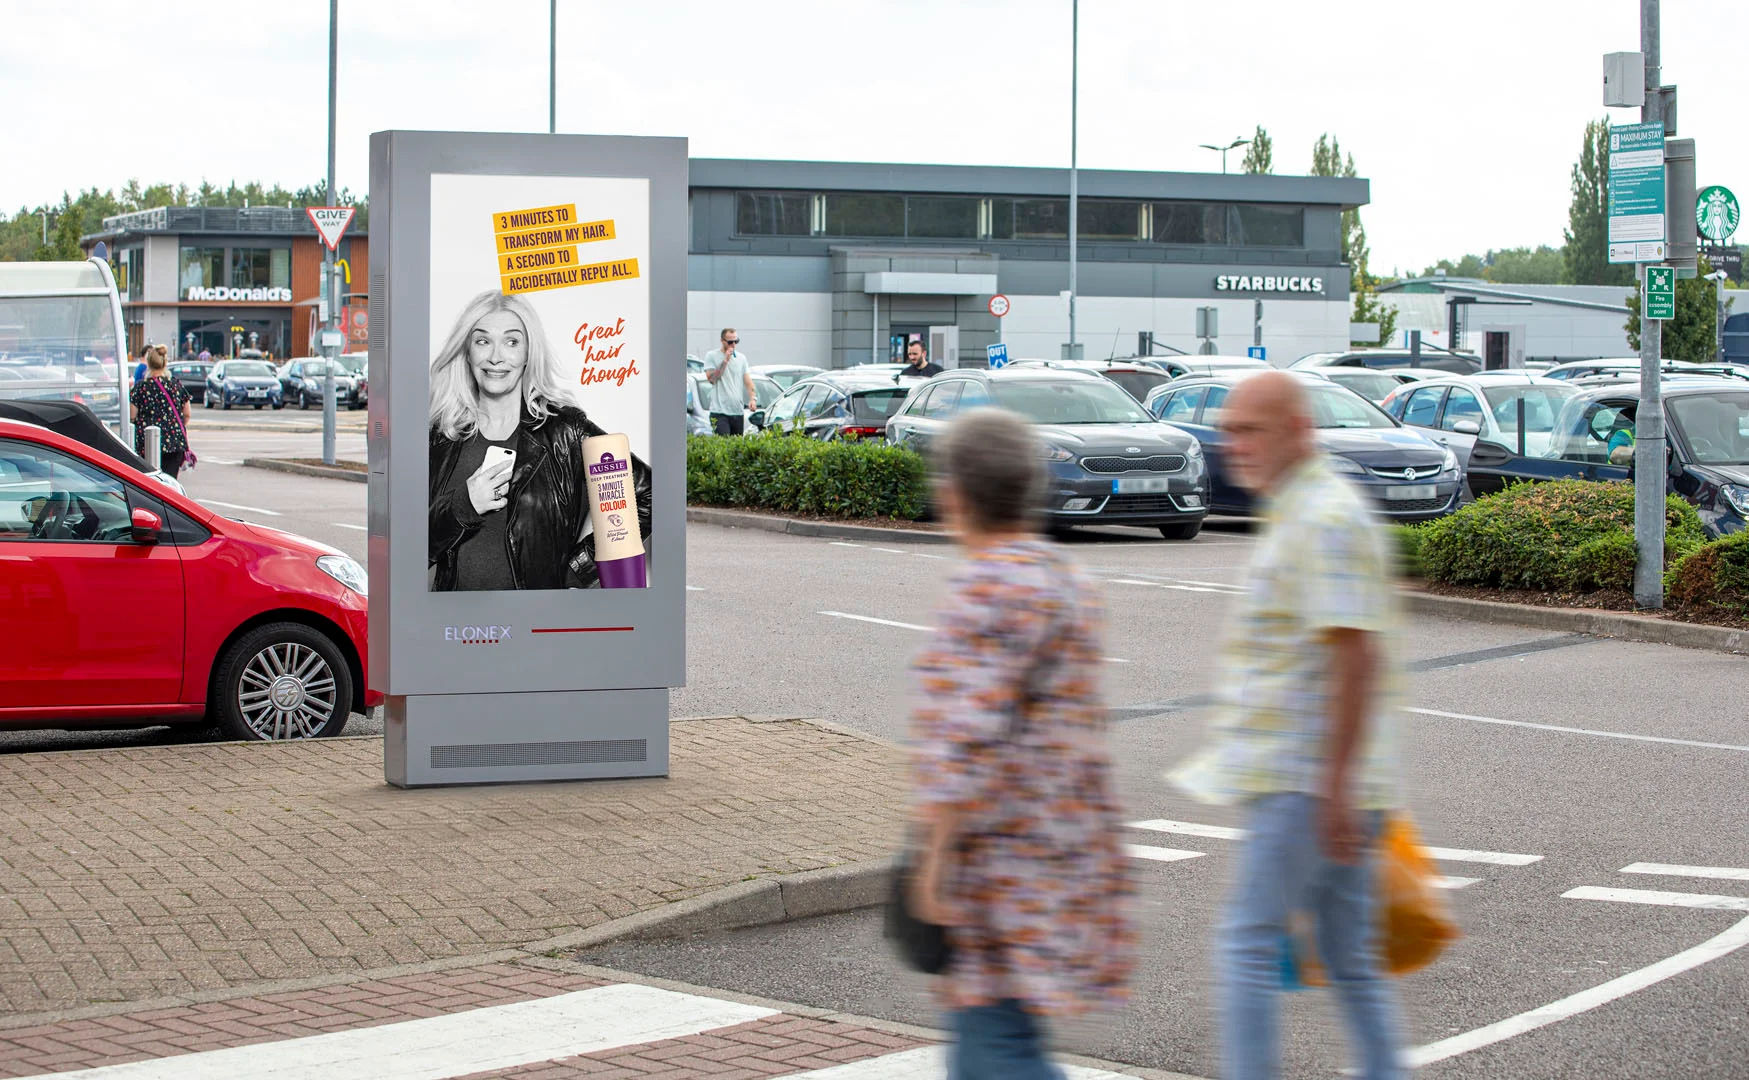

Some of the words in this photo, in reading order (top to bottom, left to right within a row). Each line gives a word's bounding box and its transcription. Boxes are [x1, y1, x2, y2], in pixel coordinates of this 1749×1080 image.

[1620, 132, 1648, 141] MAXIMUM
[1648, 130, 1662, 140] STAY
[316, 210, 347, 219] GIVE
[501, 216, 508, 229] 3
[510, 210, 554, 228] MINUTES
[556, 208, 569, 222] TO
[503, 230, 563, 250] TRANSFORM
[565, 227, 580, 241] MY
[583, 224, 609, 239] HAIR.
[507, 257, 514, 270] A
[515, 252, 555, 269] SECOND
[557, 249, 570, 263] TO
[509, 269, 578, 291] ACCIDENTALLY
[581, 265, 609, 281] REPLY
[611, 263, 632, 277] ALL.
[1216, 275, 1323, 292] STARBUCKS
[188, 286, 293, 302] McDonald's
[574, 317, 625, 351] Great
[584, 343, 626, 364] hair
[989, 346, 1006, 357] OUT
[580, 359, 641, 387] though
[591, 462, 626, 473] AUSSIE
[603, 473, 629, 481] TREATMENT
[598, 483, 602, 493] 3
[602, 480, 625, 492] MINUTE
[598, 489, 626, 502] MIRACLE
[600, 499, 627, 513] COLOUR
[445, 626, 512, 640] ELONEX
